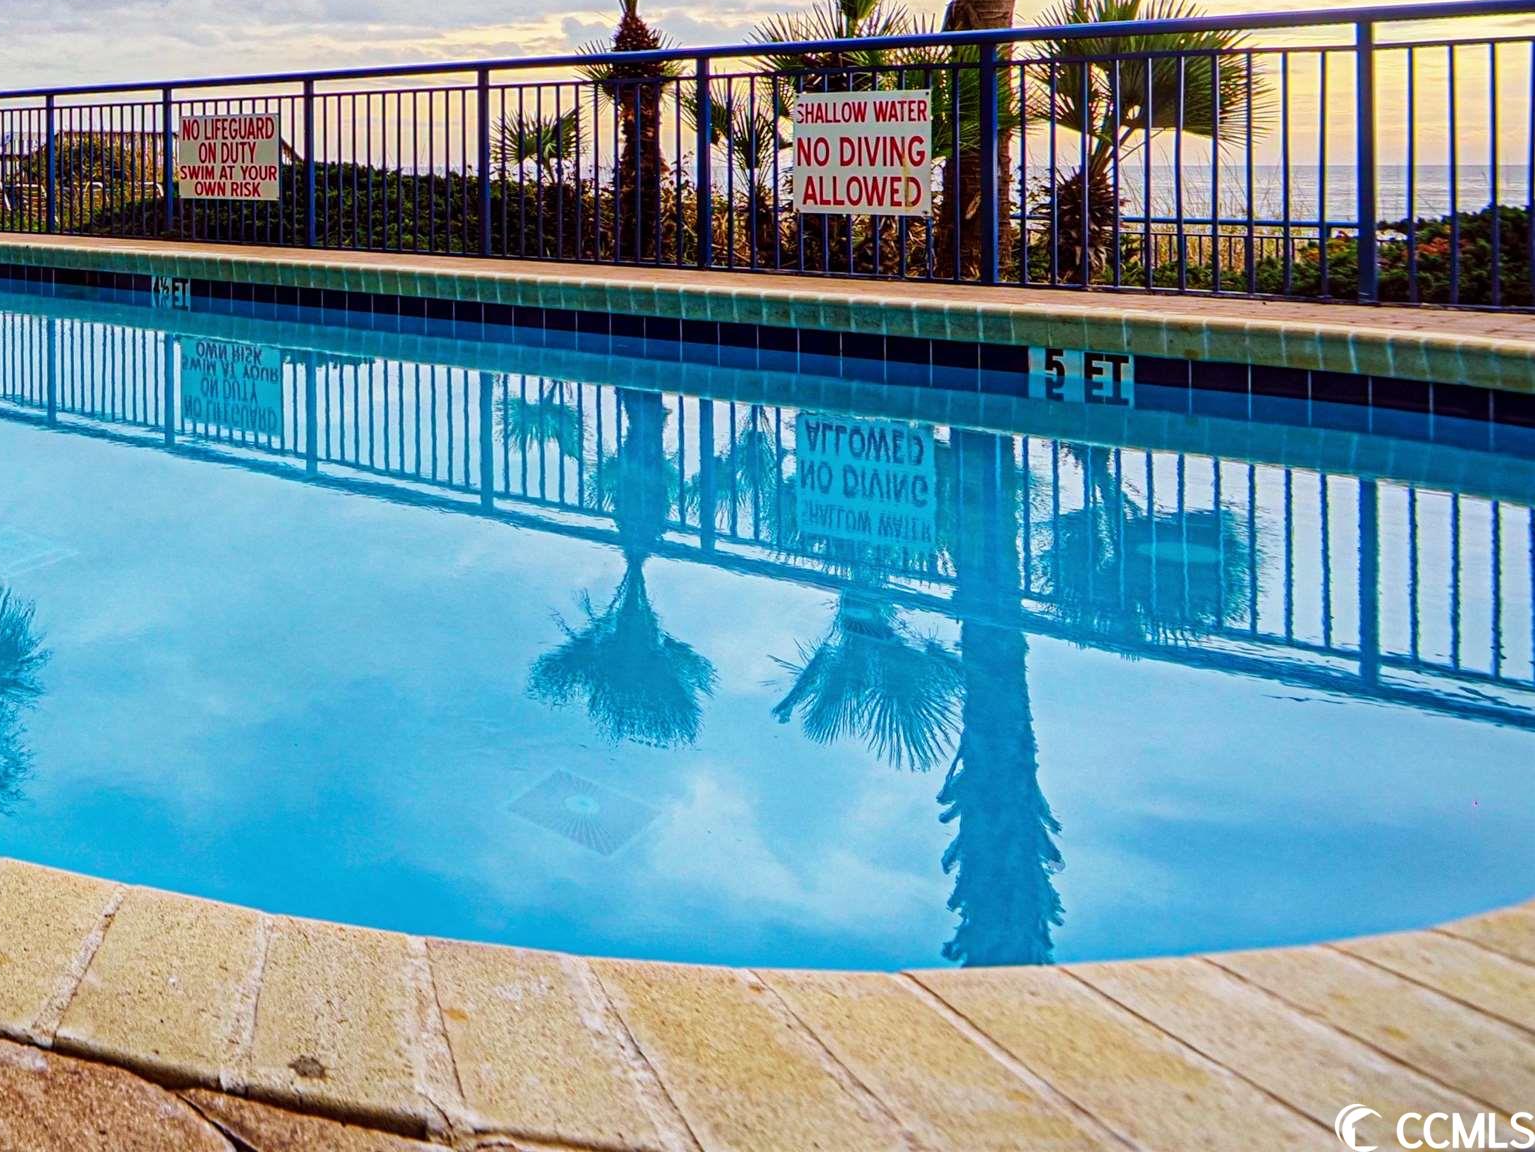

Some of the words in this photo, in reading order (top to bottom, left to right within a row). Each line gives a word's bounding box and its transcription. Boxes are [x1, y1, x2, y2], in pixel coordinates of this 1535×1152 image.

[796, 101, 868, 124] SHALLOW
[873, 100, 927, 123] WATER
[182, 119, 200, 141] NO
[204, 116, 275, 140] LIFEGUARD
[198, 142, 216, 164] ON
[221, 142, 256, 164] DUTY
[797, 137, 830, 166] NO
[839, 136, 926, 167] DIVING
[180, 165, 215, 181] SWIM
[219, 165, 235, 181] AT
[240, 165, 278, 181] YOUR
[194, 181, 226, 197] OWN
[231, 182, 261, 198] RISK
[802, 175, 922, 207] ALLOWED
[1044, 348, 1066, 378] 5
[1084, 352, 1130, 382] FT
